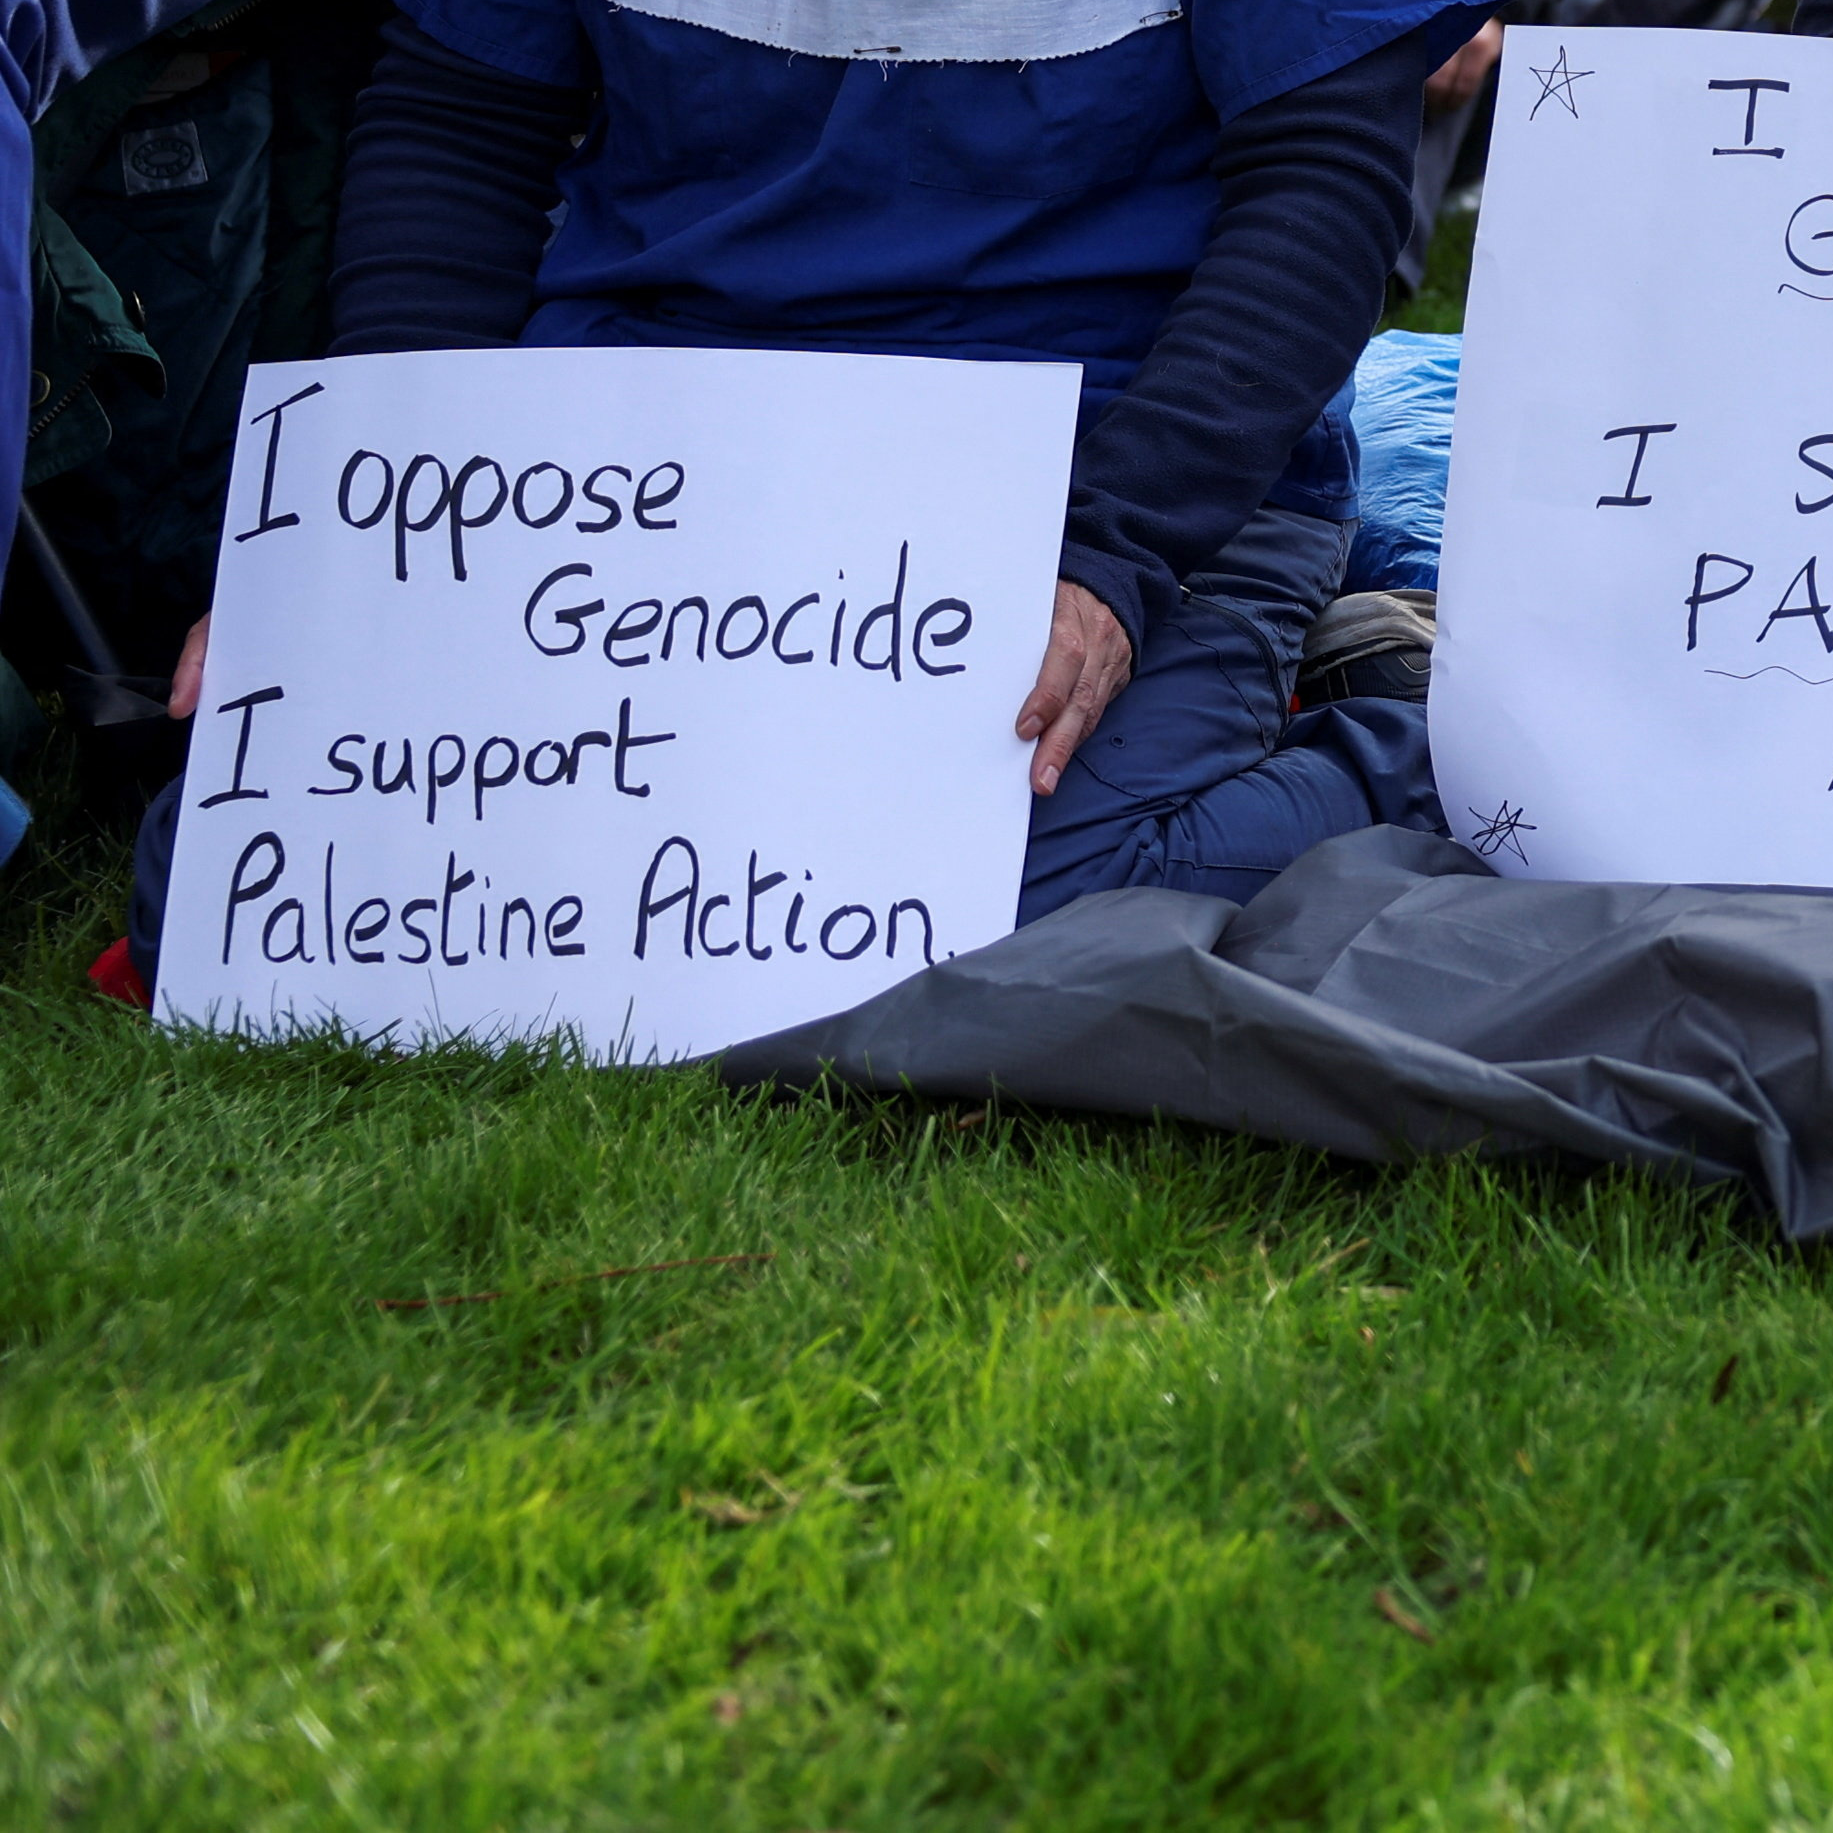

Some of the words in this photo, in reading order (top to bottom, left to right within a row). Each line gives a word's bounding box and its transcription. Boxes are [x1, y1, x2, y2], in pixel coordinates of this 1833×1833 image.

[1708, 79, 1789, 159] I
[235, 383, 324, 542] I
[338, 449, 684, 581] oppose
[1597, 424, 1677, 508] I
[524, 541, 972, 682] Genocide
[199, 686, 284, 809] I
[307, 698, 676, 824] support
[223, 832, 585, 966] Palestine
